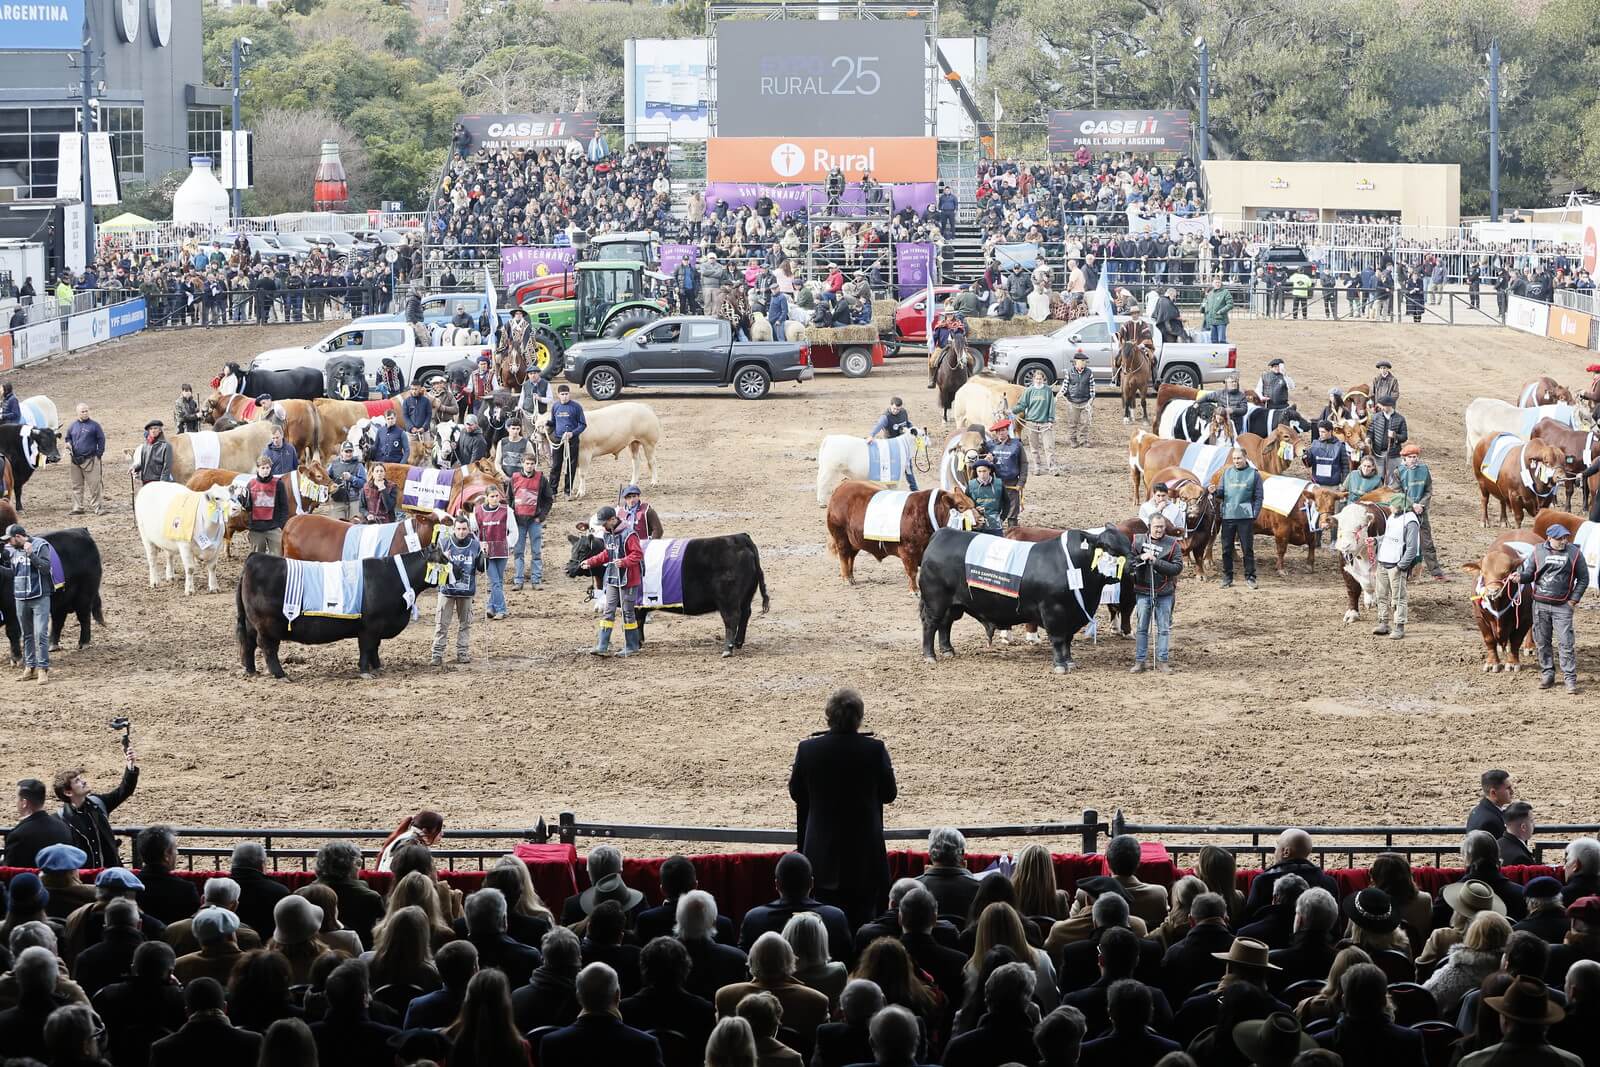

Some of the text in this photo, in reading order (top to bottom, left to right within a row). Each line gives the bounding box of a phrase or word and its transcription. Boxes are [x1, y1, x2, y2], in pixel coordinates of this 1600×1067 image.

[761, 56, 881, 95] RURAL 25
[488, 122, 545, 137] CASE
[1080, 120, 1138, 135] CASE
[1073, 136, 1166, 146] PARA EL CAMPO ARGENTINO
[813, 147, 875, 171] Rural
[505, 250, 523, 265] SAN
